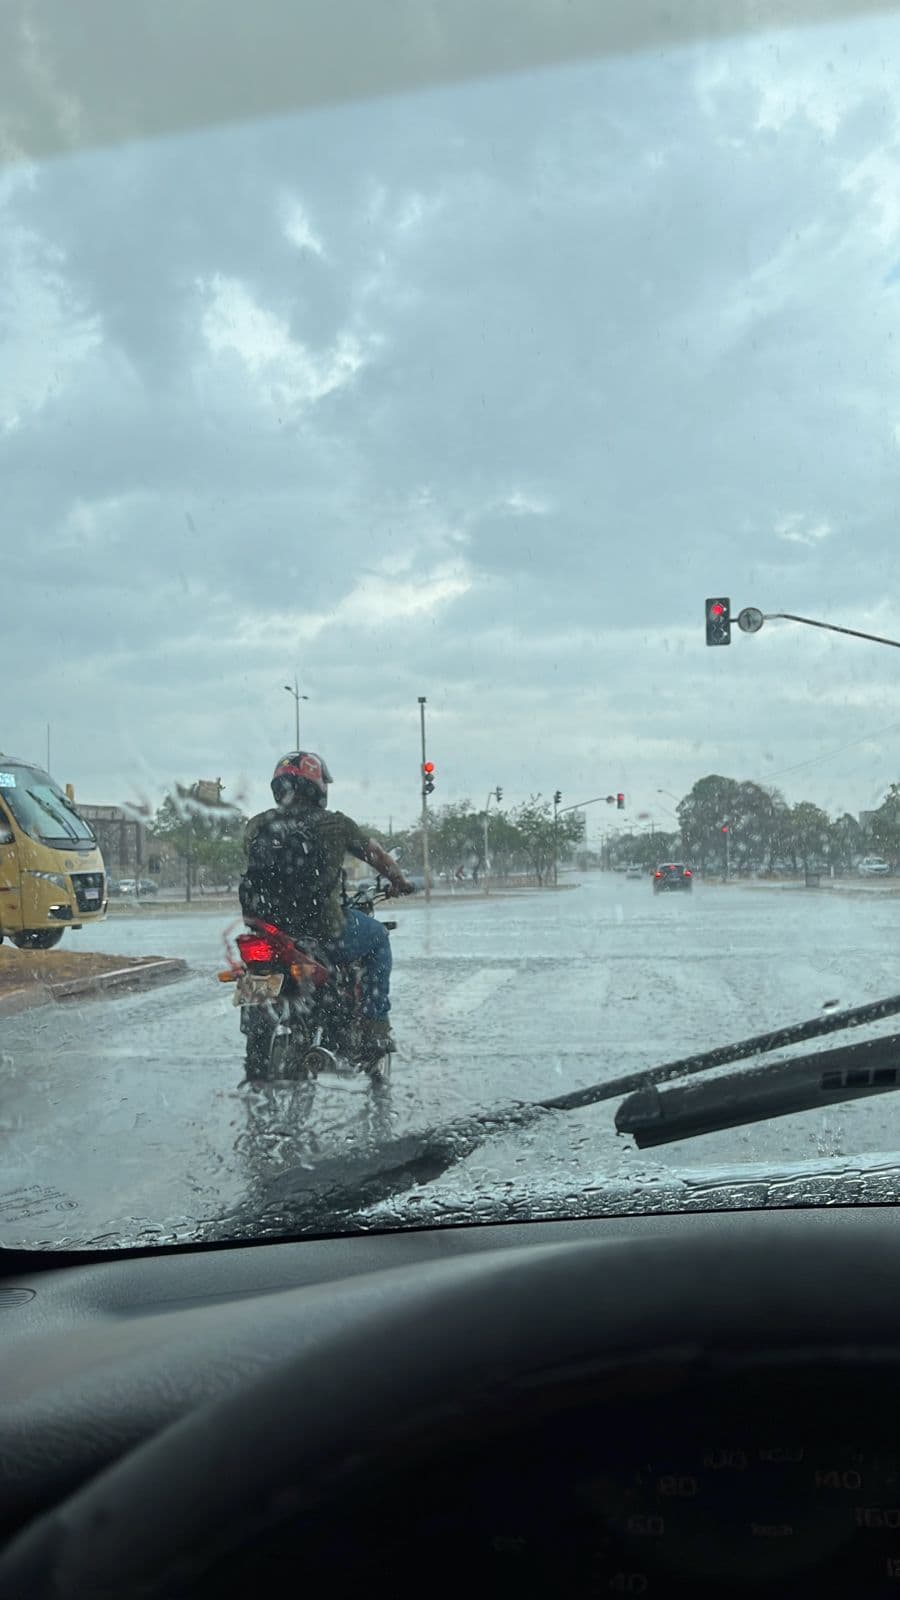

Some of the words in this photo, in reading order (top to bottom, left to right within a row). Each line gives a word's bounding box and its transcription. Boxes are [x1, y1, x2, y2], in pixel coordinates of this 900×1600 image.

[660, 1475, 697, 1496] 80
[815, 1470, 861, 1489] 140
[627, 1515, 665, 1535] 60
[856, 1507, 900, 1528] 160
[608, 1573, 648, 1593] 40
